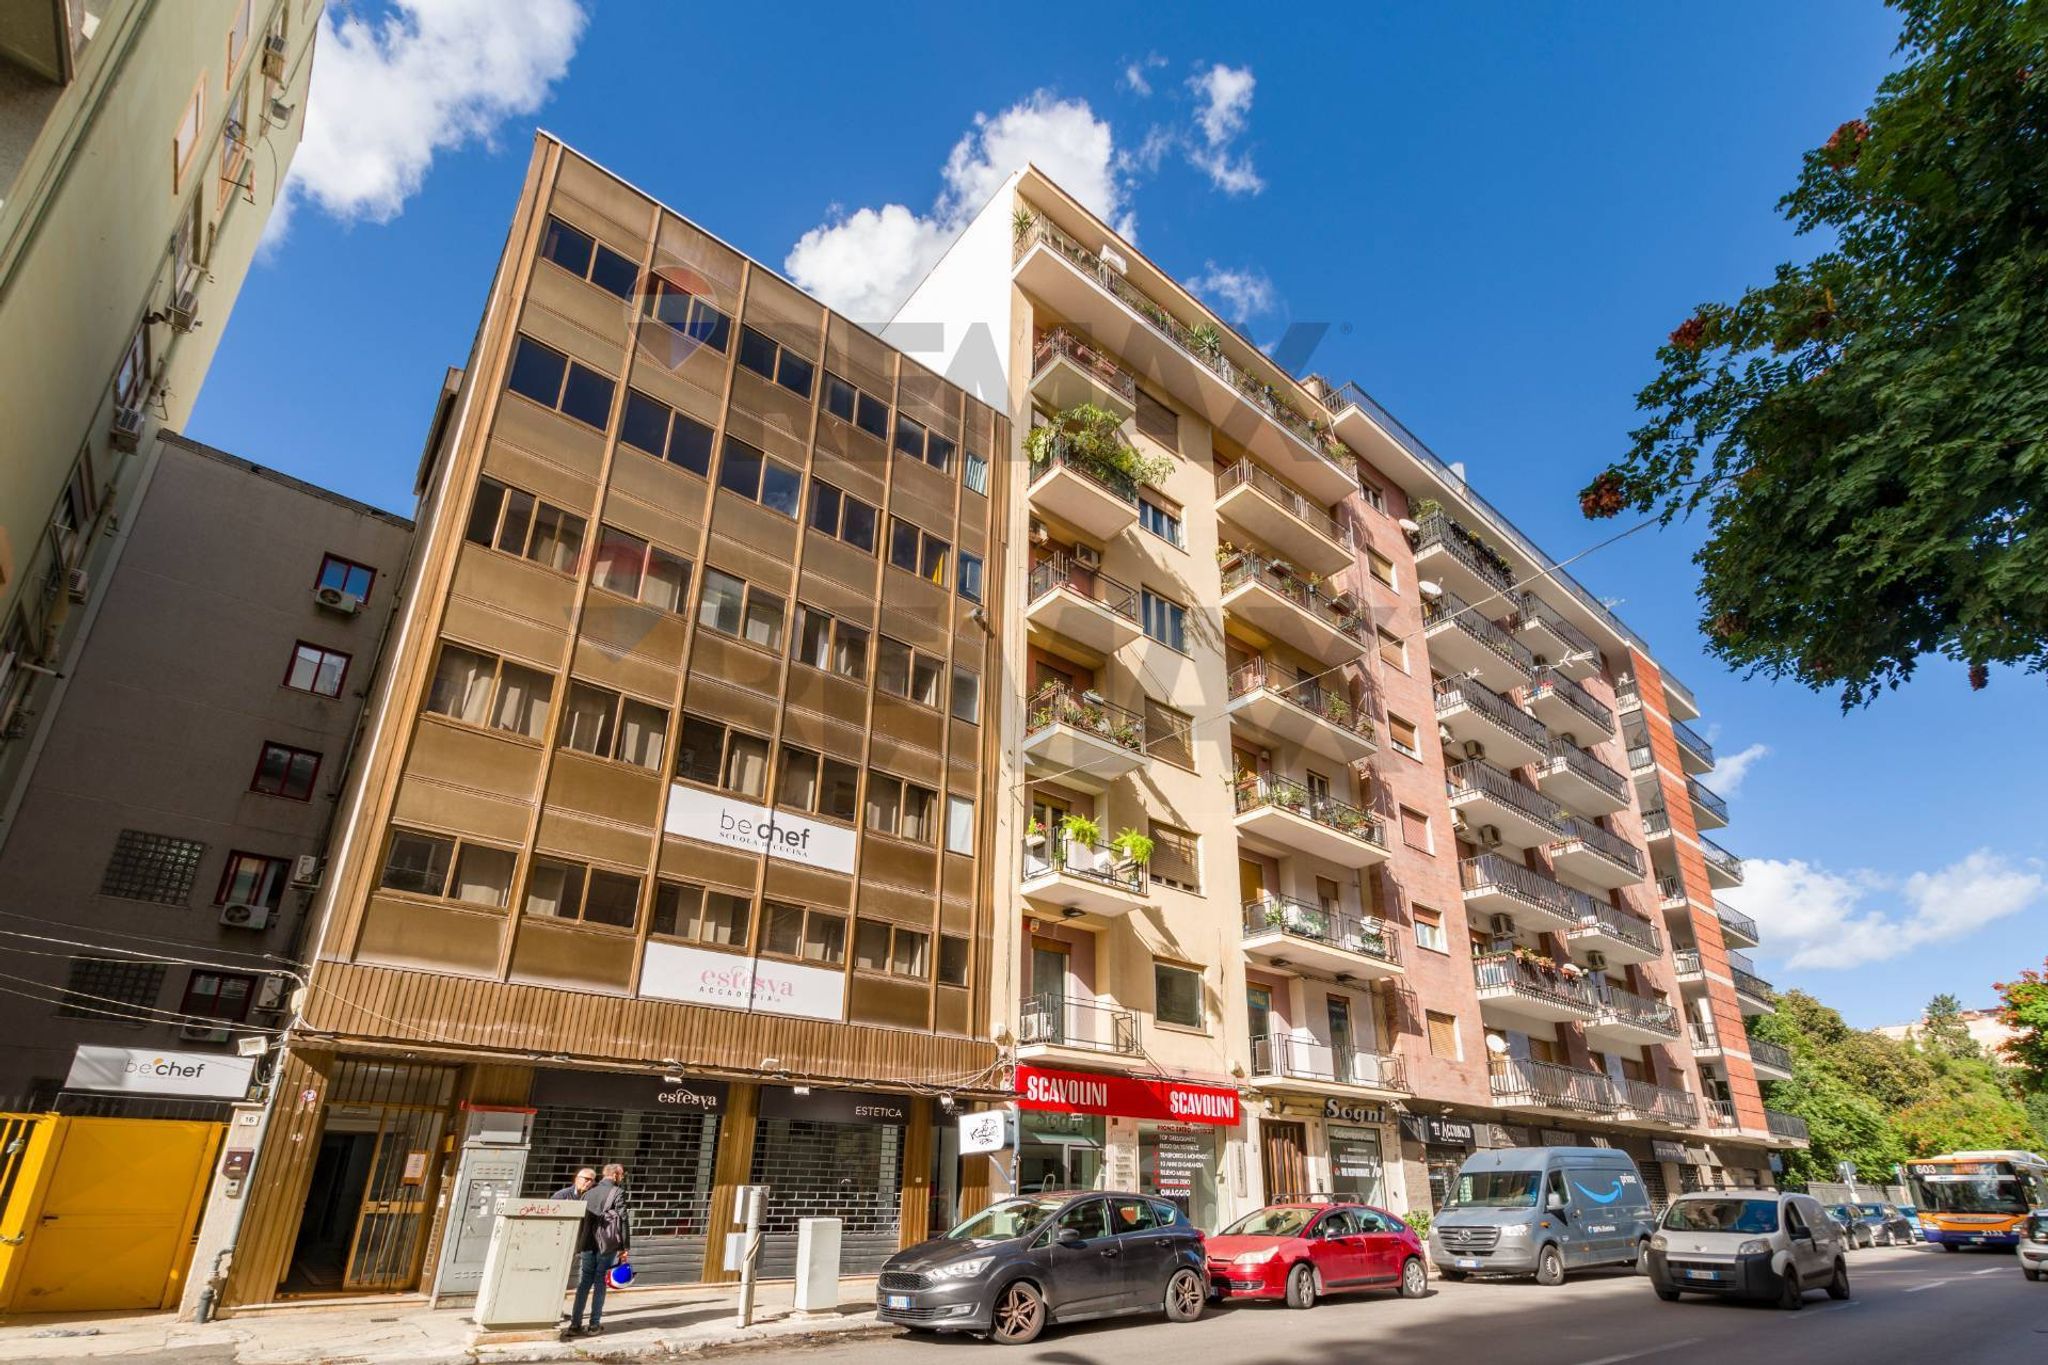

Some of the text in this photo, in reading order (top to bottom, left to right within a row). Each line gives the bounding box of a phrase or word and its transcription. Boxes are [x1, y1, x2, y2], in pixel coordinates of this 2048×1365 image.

[720, 808, 810, 849] be chef
[719, 832, 758, 845] SCUOLA
[773, 845, 808, 858] CUCINA
[124, 1058, 152, 1074] be
[155, 1061, 206, 1078] chef
[1026, 1075, 1108, 1108] SCAVOLINI
[855, 1105, 903, 1118] ESTETICA
[1169, 1090, 1235, 1119] SCAVOLINI
[1325, 1098, 1386, 1123] Sogni
[1916, 1164, 1937, 1175] 603
